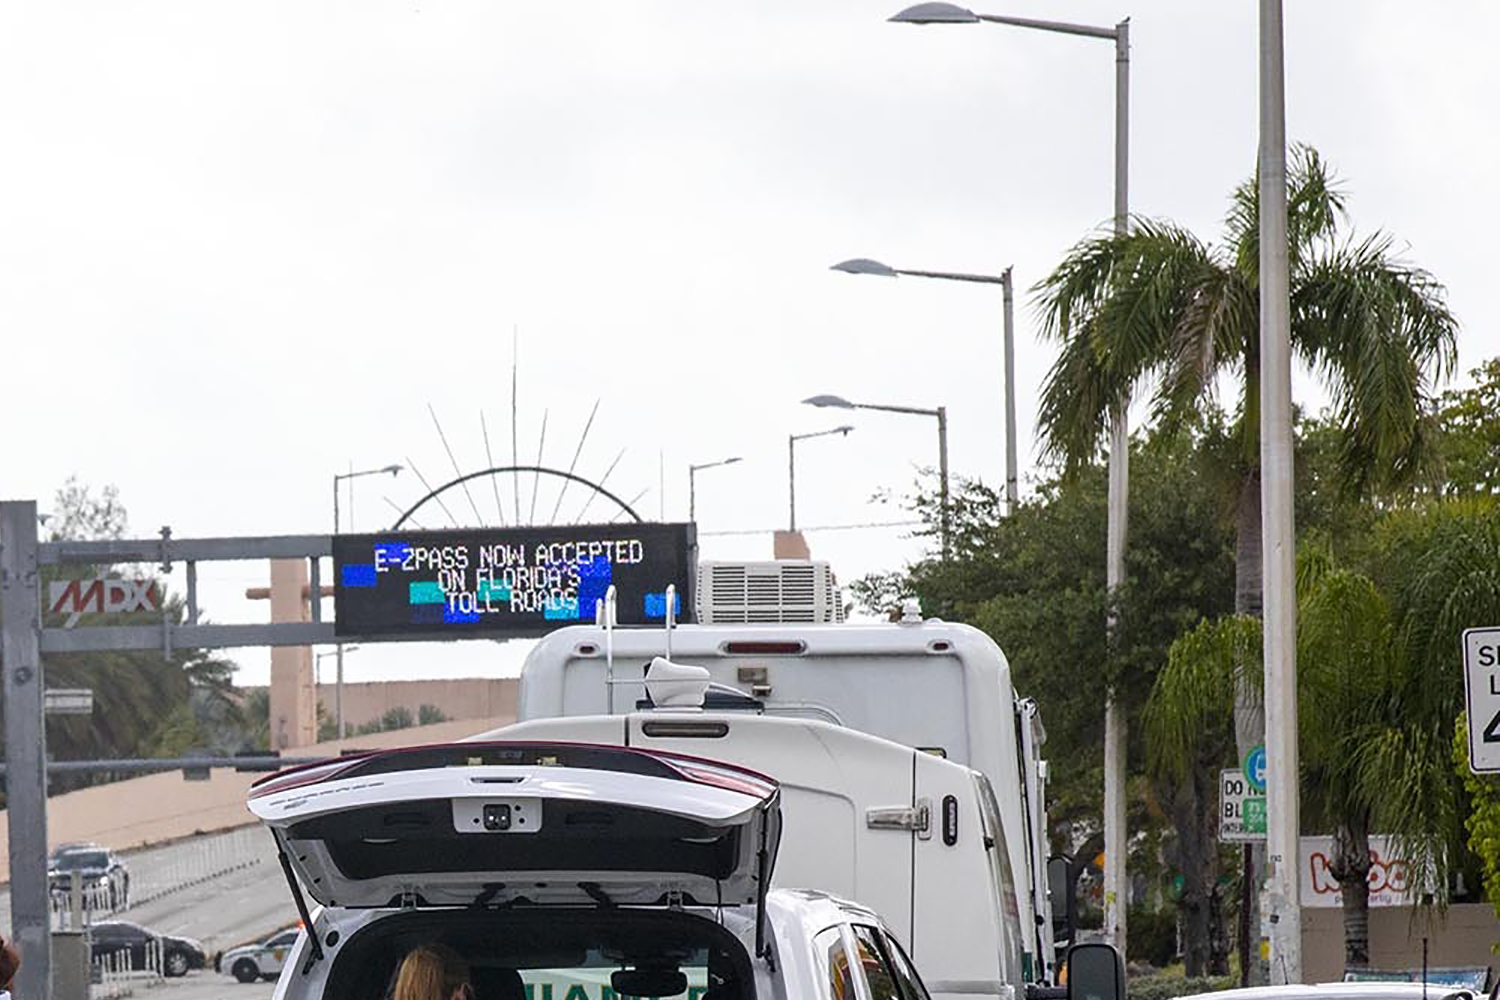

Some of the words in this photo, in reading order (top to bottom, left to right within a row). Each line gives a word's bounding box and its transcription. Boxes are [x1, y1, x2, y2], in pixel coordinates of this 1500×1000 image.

[480, 545, 524, 567] NOW
[536, 540, 643, 565] ACCEPTED
[438, 568, 465, 591] ON
[476, 565, 581, 591] FLORIDA'S
[50, 579, 157, 613] MDX
[447, 590, 499, 613] TOLL
[511, 588, 578, 613] ROADS
[1225, 780, 1243, 796] DO
